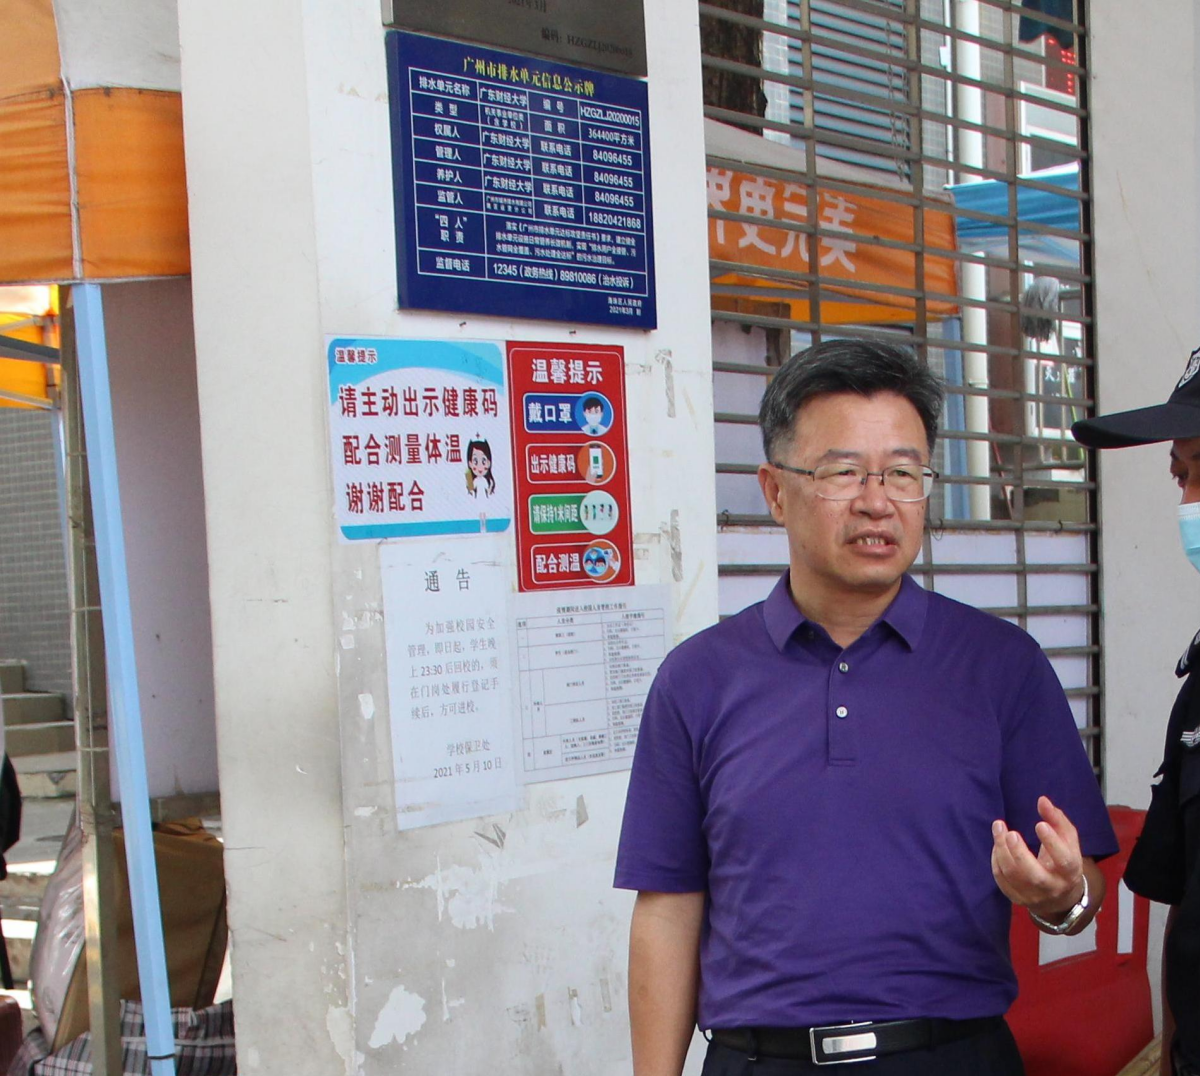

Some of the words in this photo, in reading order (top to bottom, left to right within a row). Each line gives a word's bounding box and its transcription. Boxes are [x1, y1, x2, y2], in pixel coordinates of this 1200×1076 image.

[463, 56, 595, 97] 广州市排水单元信息公示牌
[419, 75, 471, 97] 排水单元名称
[480, 87, 528, 107] 广东财经大学
[434, 101, 458, 117] 类型
[434, 122, 460, 138] 权属人
[544, 120, 566, 134] 面积
[482, 131, 530, 150] 广东财经大学
[588, 128, 635, 147] 364400平方米
[435, 145, 462, 161] 管理人
[540, 140, 572, 157] 联系电话
[592, 149, 633, 166] 84096455
[484, 153, 531, 172] 广东财经大学
[541, 161, 573, 178] 联系电话
[436, 168, 463, 183] 养护人
[484, 175, 533, 193] 广东财经大学
[593, 171, 634, 188] 84096455
[437, 189, 464, 205] 监管人
[542, 182, 574, 199] 联系电话
[594, 191, 635, 207] 84096455
[543, 204, 575, 219] 联系电话
[588, 211, 642, 229] 18820421868
[435, 256, 470, 272] 监督电话
[336, 348, 377, 364] 温馨提示
[531, 358, 603, 385] 温馨提示
[338, 385, 498, 418] 请主动出示健康码
[527, 402, 572, 424] 戴口罩
[342, 433, 462, 466] 配合测量体温
[530, 454, 576, 475] 出示健康码
[346, 480, 425, 514] 谢谢配合
[532, 504, 579, 524] 请保持1米间距
[535, 553, 581, 574] 配合测温
[424, 568, 471, 593] 通告
[425, 617, 496, 636] 为加强校园安全
[410, 677, 499, 699] 在门岗处履行登记手
[446, 739, 490, 757] 学校保卫处
